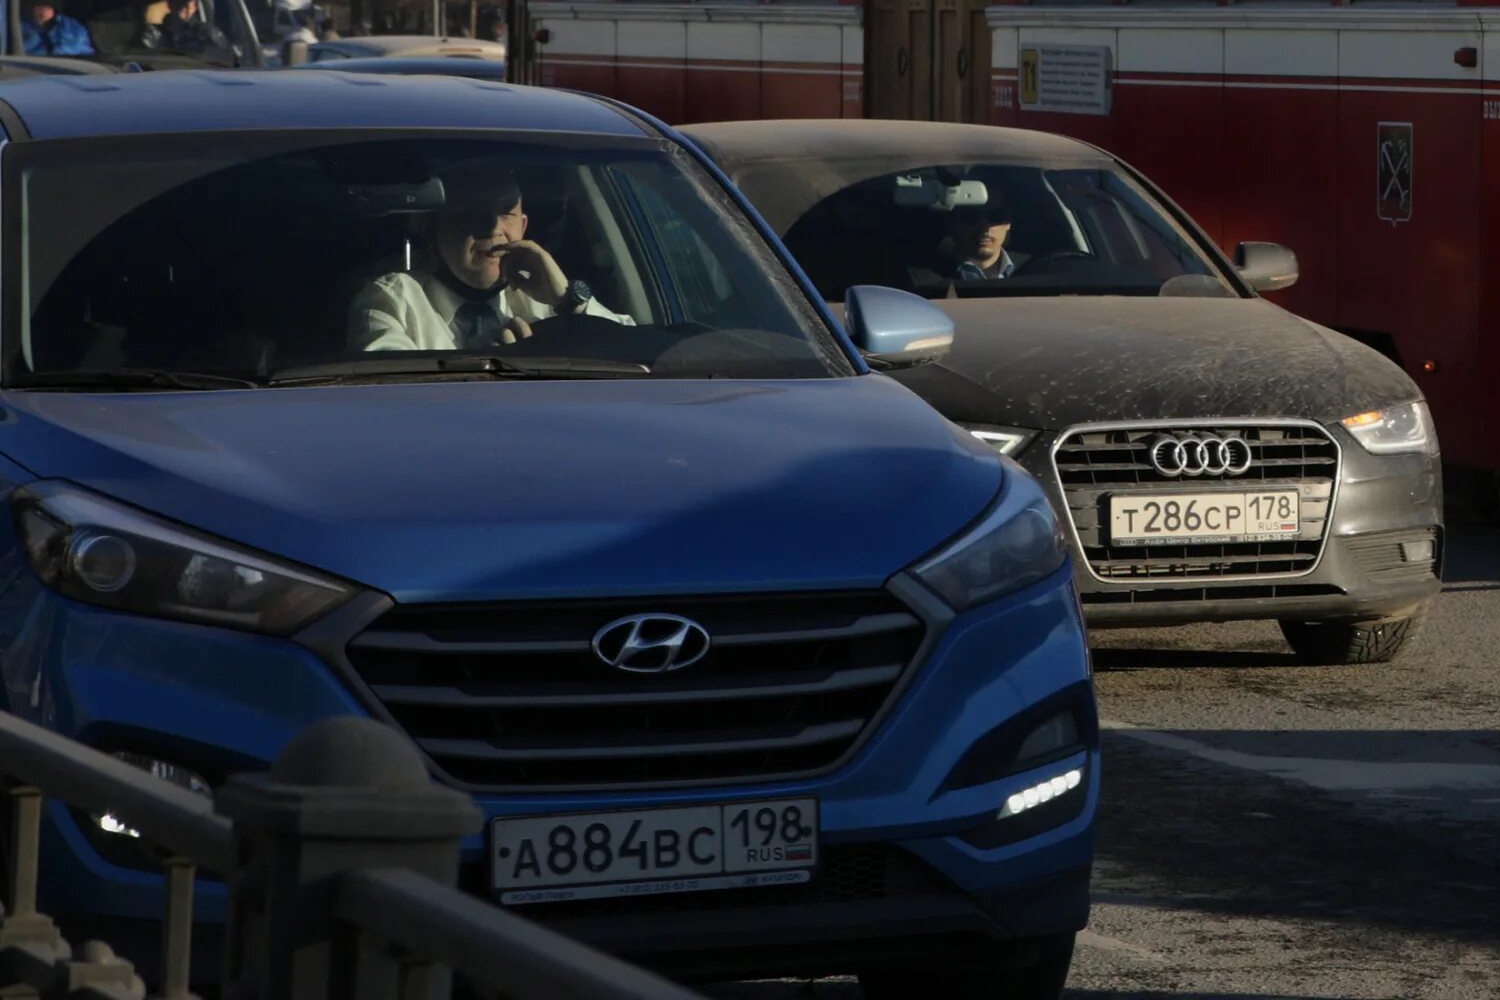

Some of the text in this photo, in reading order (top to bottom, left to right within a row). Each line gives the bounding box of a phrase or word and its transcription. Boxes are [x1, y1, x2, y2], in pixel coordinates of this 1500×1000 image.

[1122, 495, 1291, 533] Т286СР 178
[1258, 522, 1280, 531] RUS
[512, 805, 803, 879] А884ВС 198
[747, 847, 784, 863] RUS
